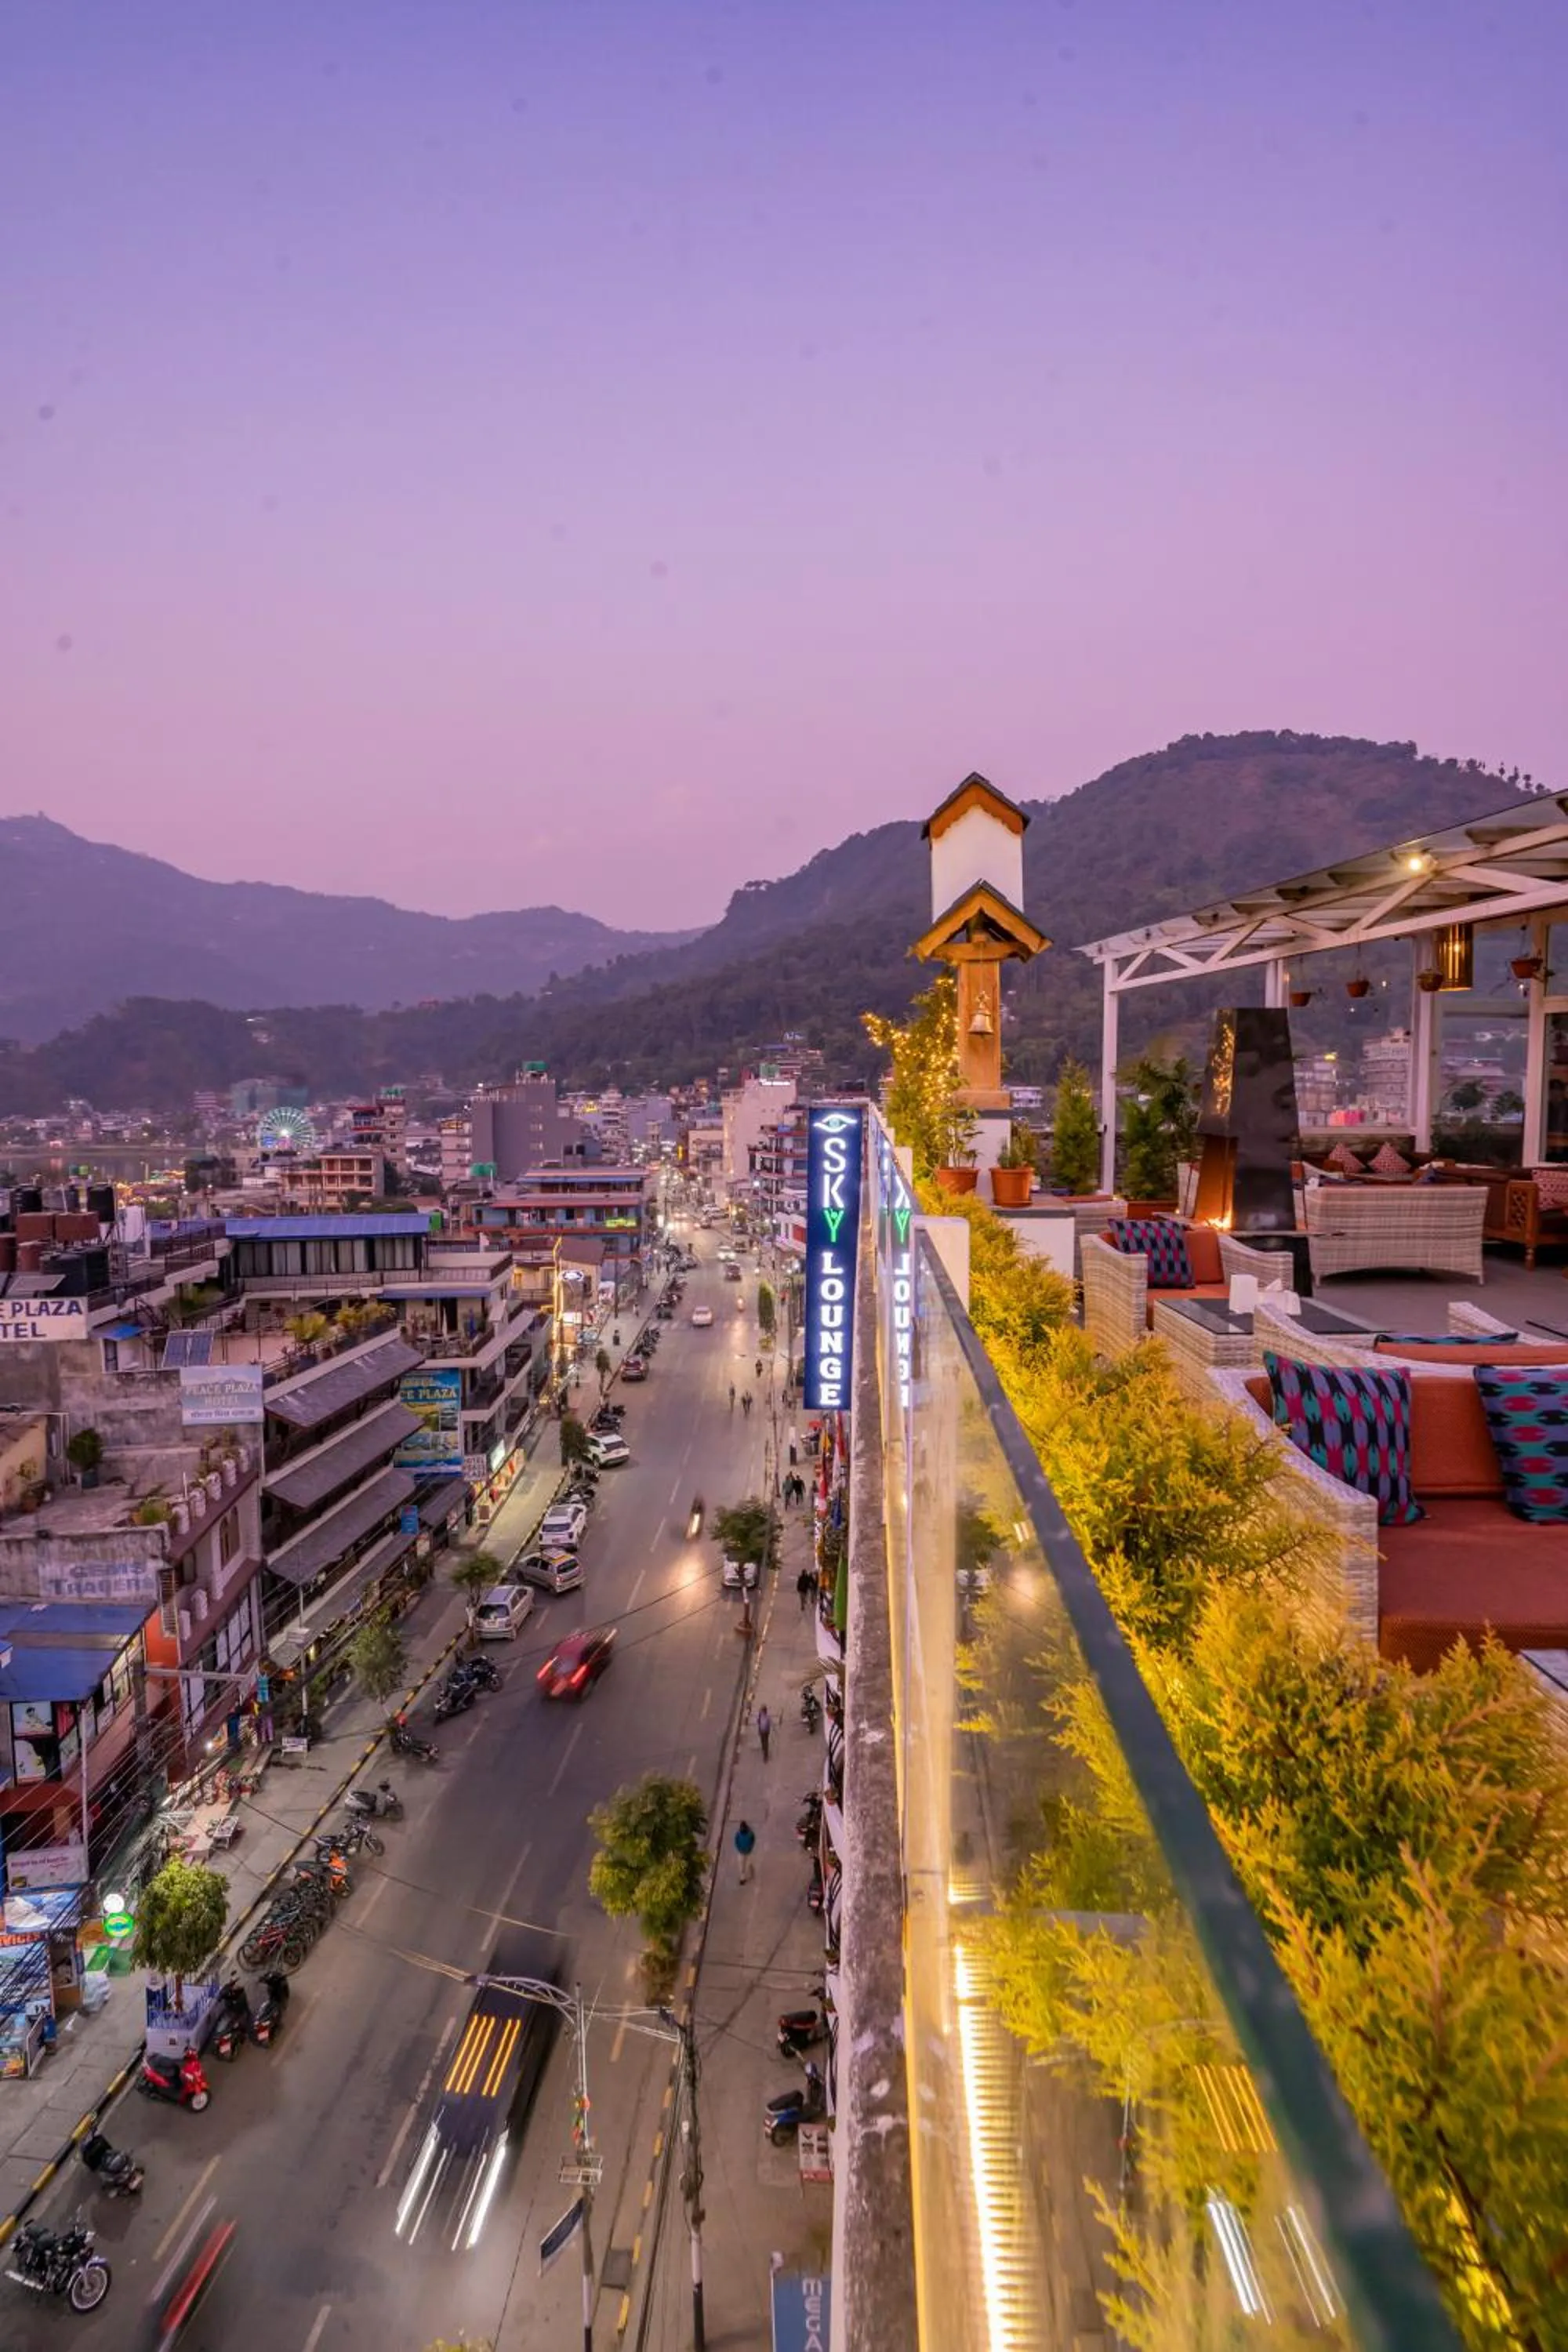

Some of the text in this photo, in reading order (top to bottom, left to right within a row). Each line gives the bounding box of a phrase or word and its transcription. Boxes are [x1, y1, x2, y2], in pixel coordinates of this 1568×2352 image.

[819, 1137, 847, 1406] SKY LOUNGE
[11, 1300, 82, 1318] PLAZA
[224, 1383, 260, 1394] PLAZA
[419, 1387, 458, 1400] PLAZA
